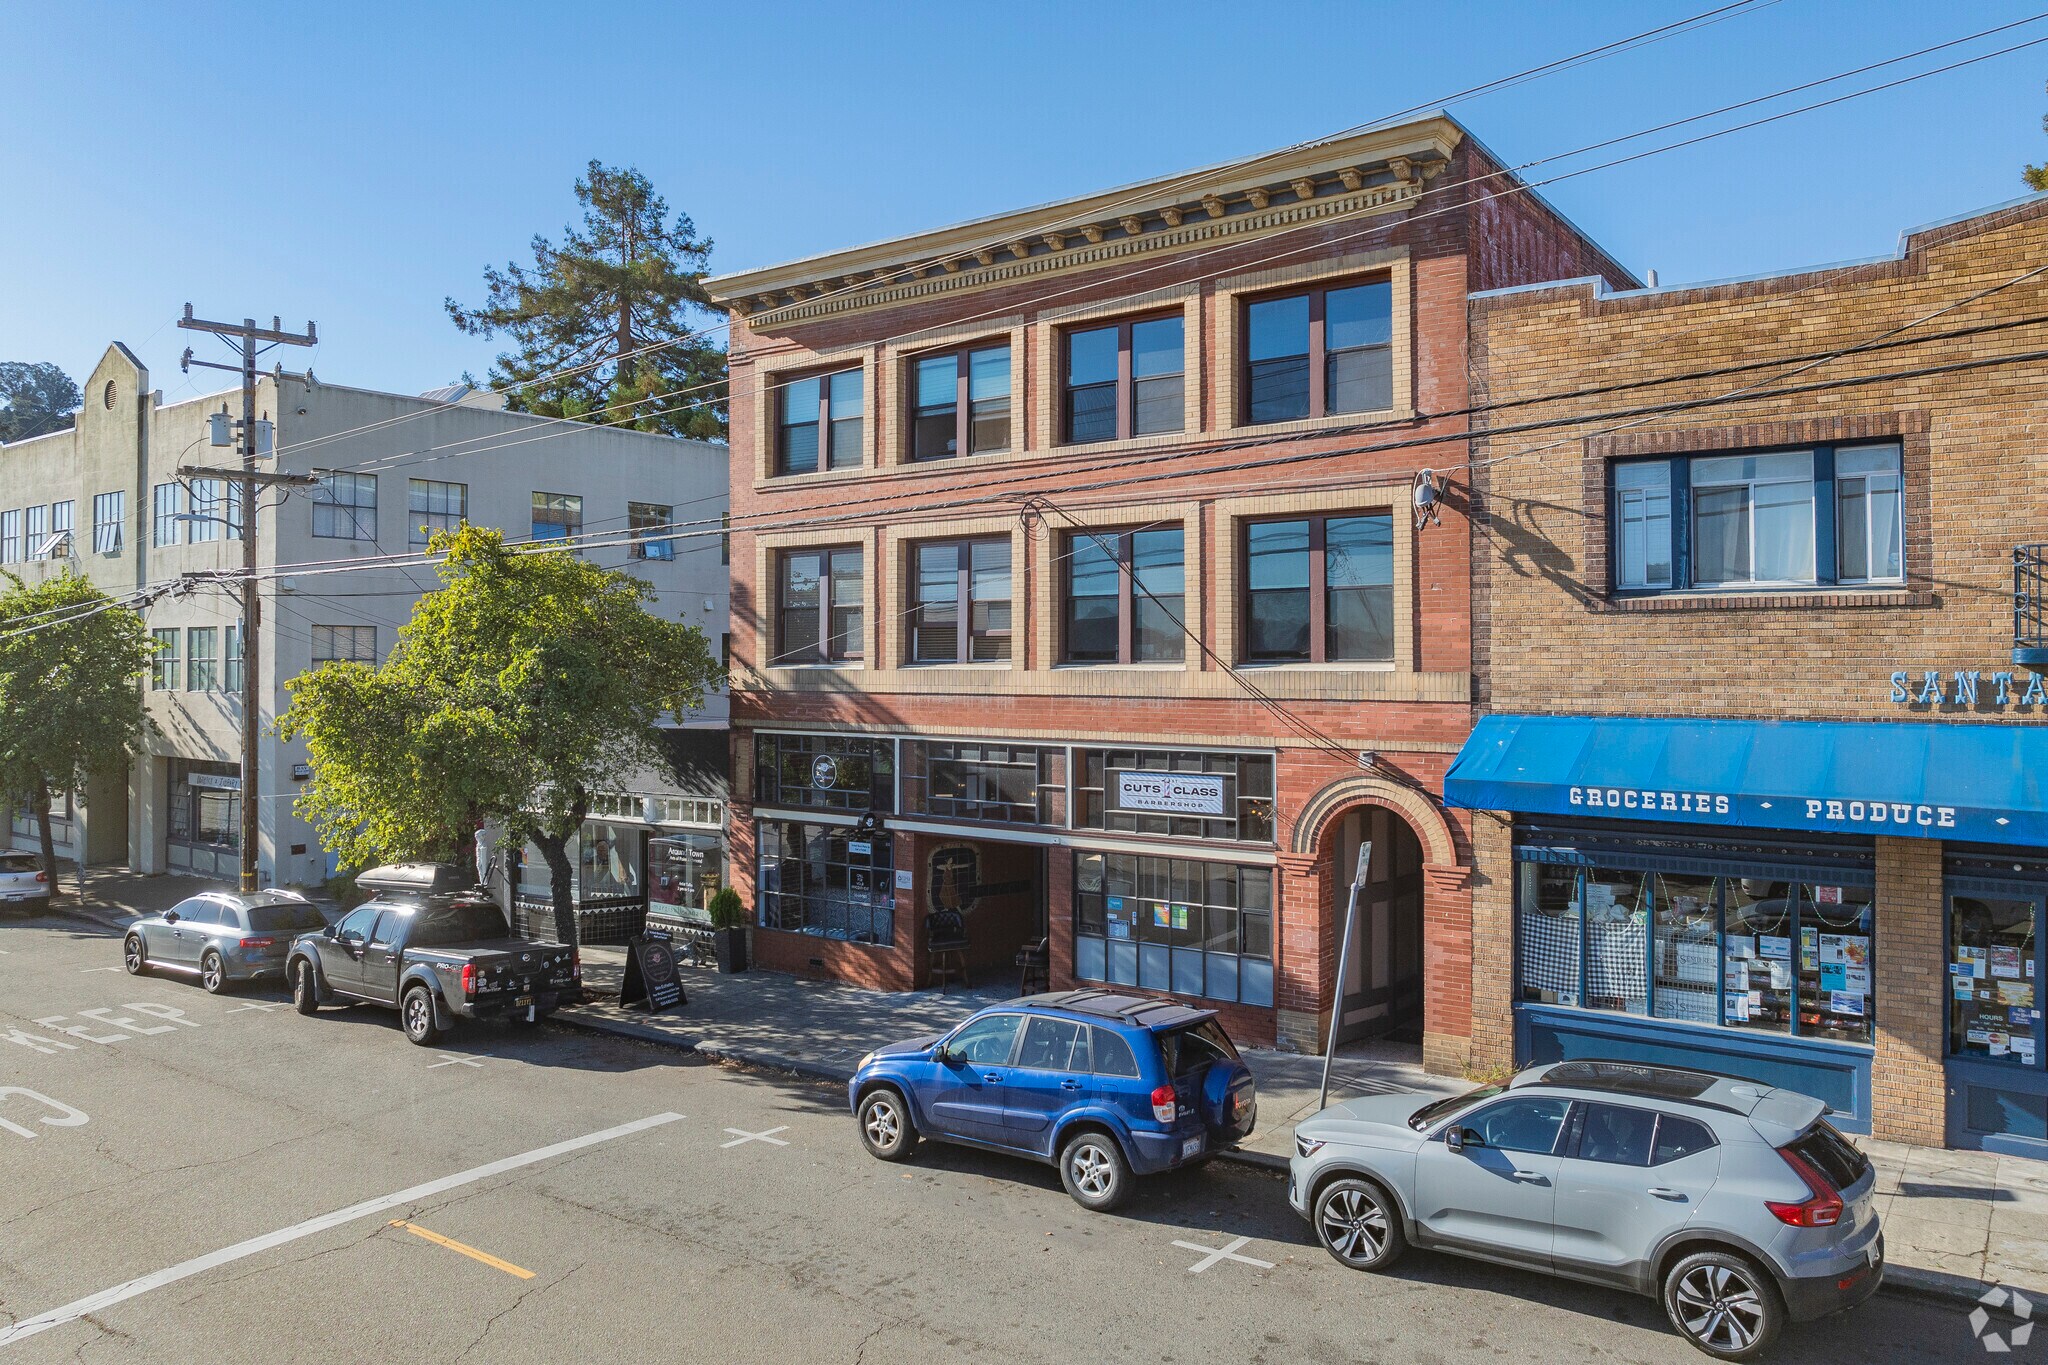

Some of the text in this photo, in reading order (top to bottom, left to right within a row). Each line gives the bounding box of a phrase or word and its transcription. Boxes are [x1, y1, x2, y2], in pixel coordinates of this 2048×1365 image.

[1891, 671, 2048, 705] SANTA
[1124, 784, 1161, 794] CUTS
[1173, 786, 1219, 797] CLASS
[1137, 799, 1204, 808] BARBERSHOP
[1569, 787, 1955, 827] GROCERIES PRODUCE
[689, 849, 704, 858] Town
